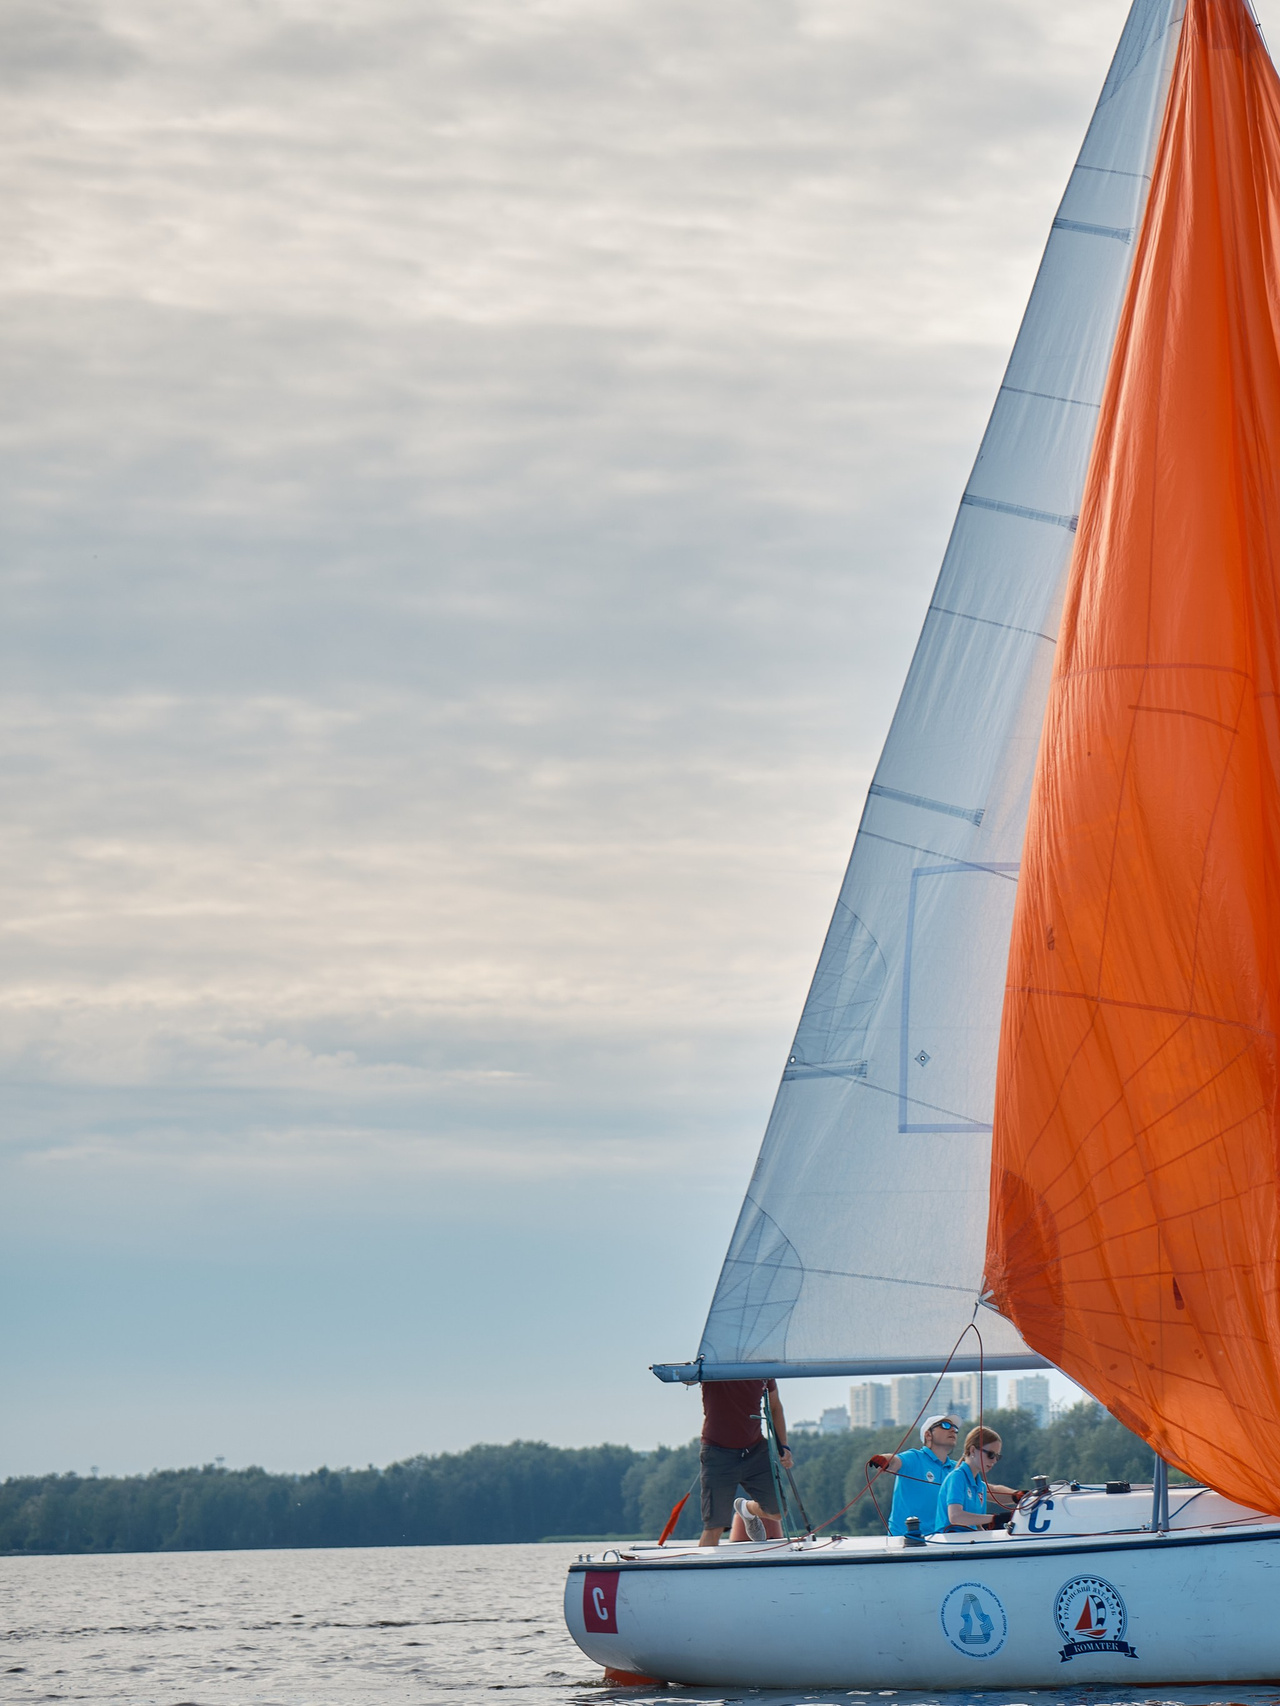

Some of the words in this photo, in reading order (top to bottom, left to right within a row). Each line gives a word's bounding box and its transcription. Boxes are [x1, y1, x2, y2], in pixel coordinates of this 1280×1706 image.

[1028, 1500, 1054, 1533] C
[592, 1587, 608, 1620] C
[1064, 1585, 1091, 1620] ГУБЕРНСКИЙ
[1092, 1586, 1116, 1616] ЯХТ-КЛУБ
[1073, 1642, 1119, 1653] КОМАТЕК
